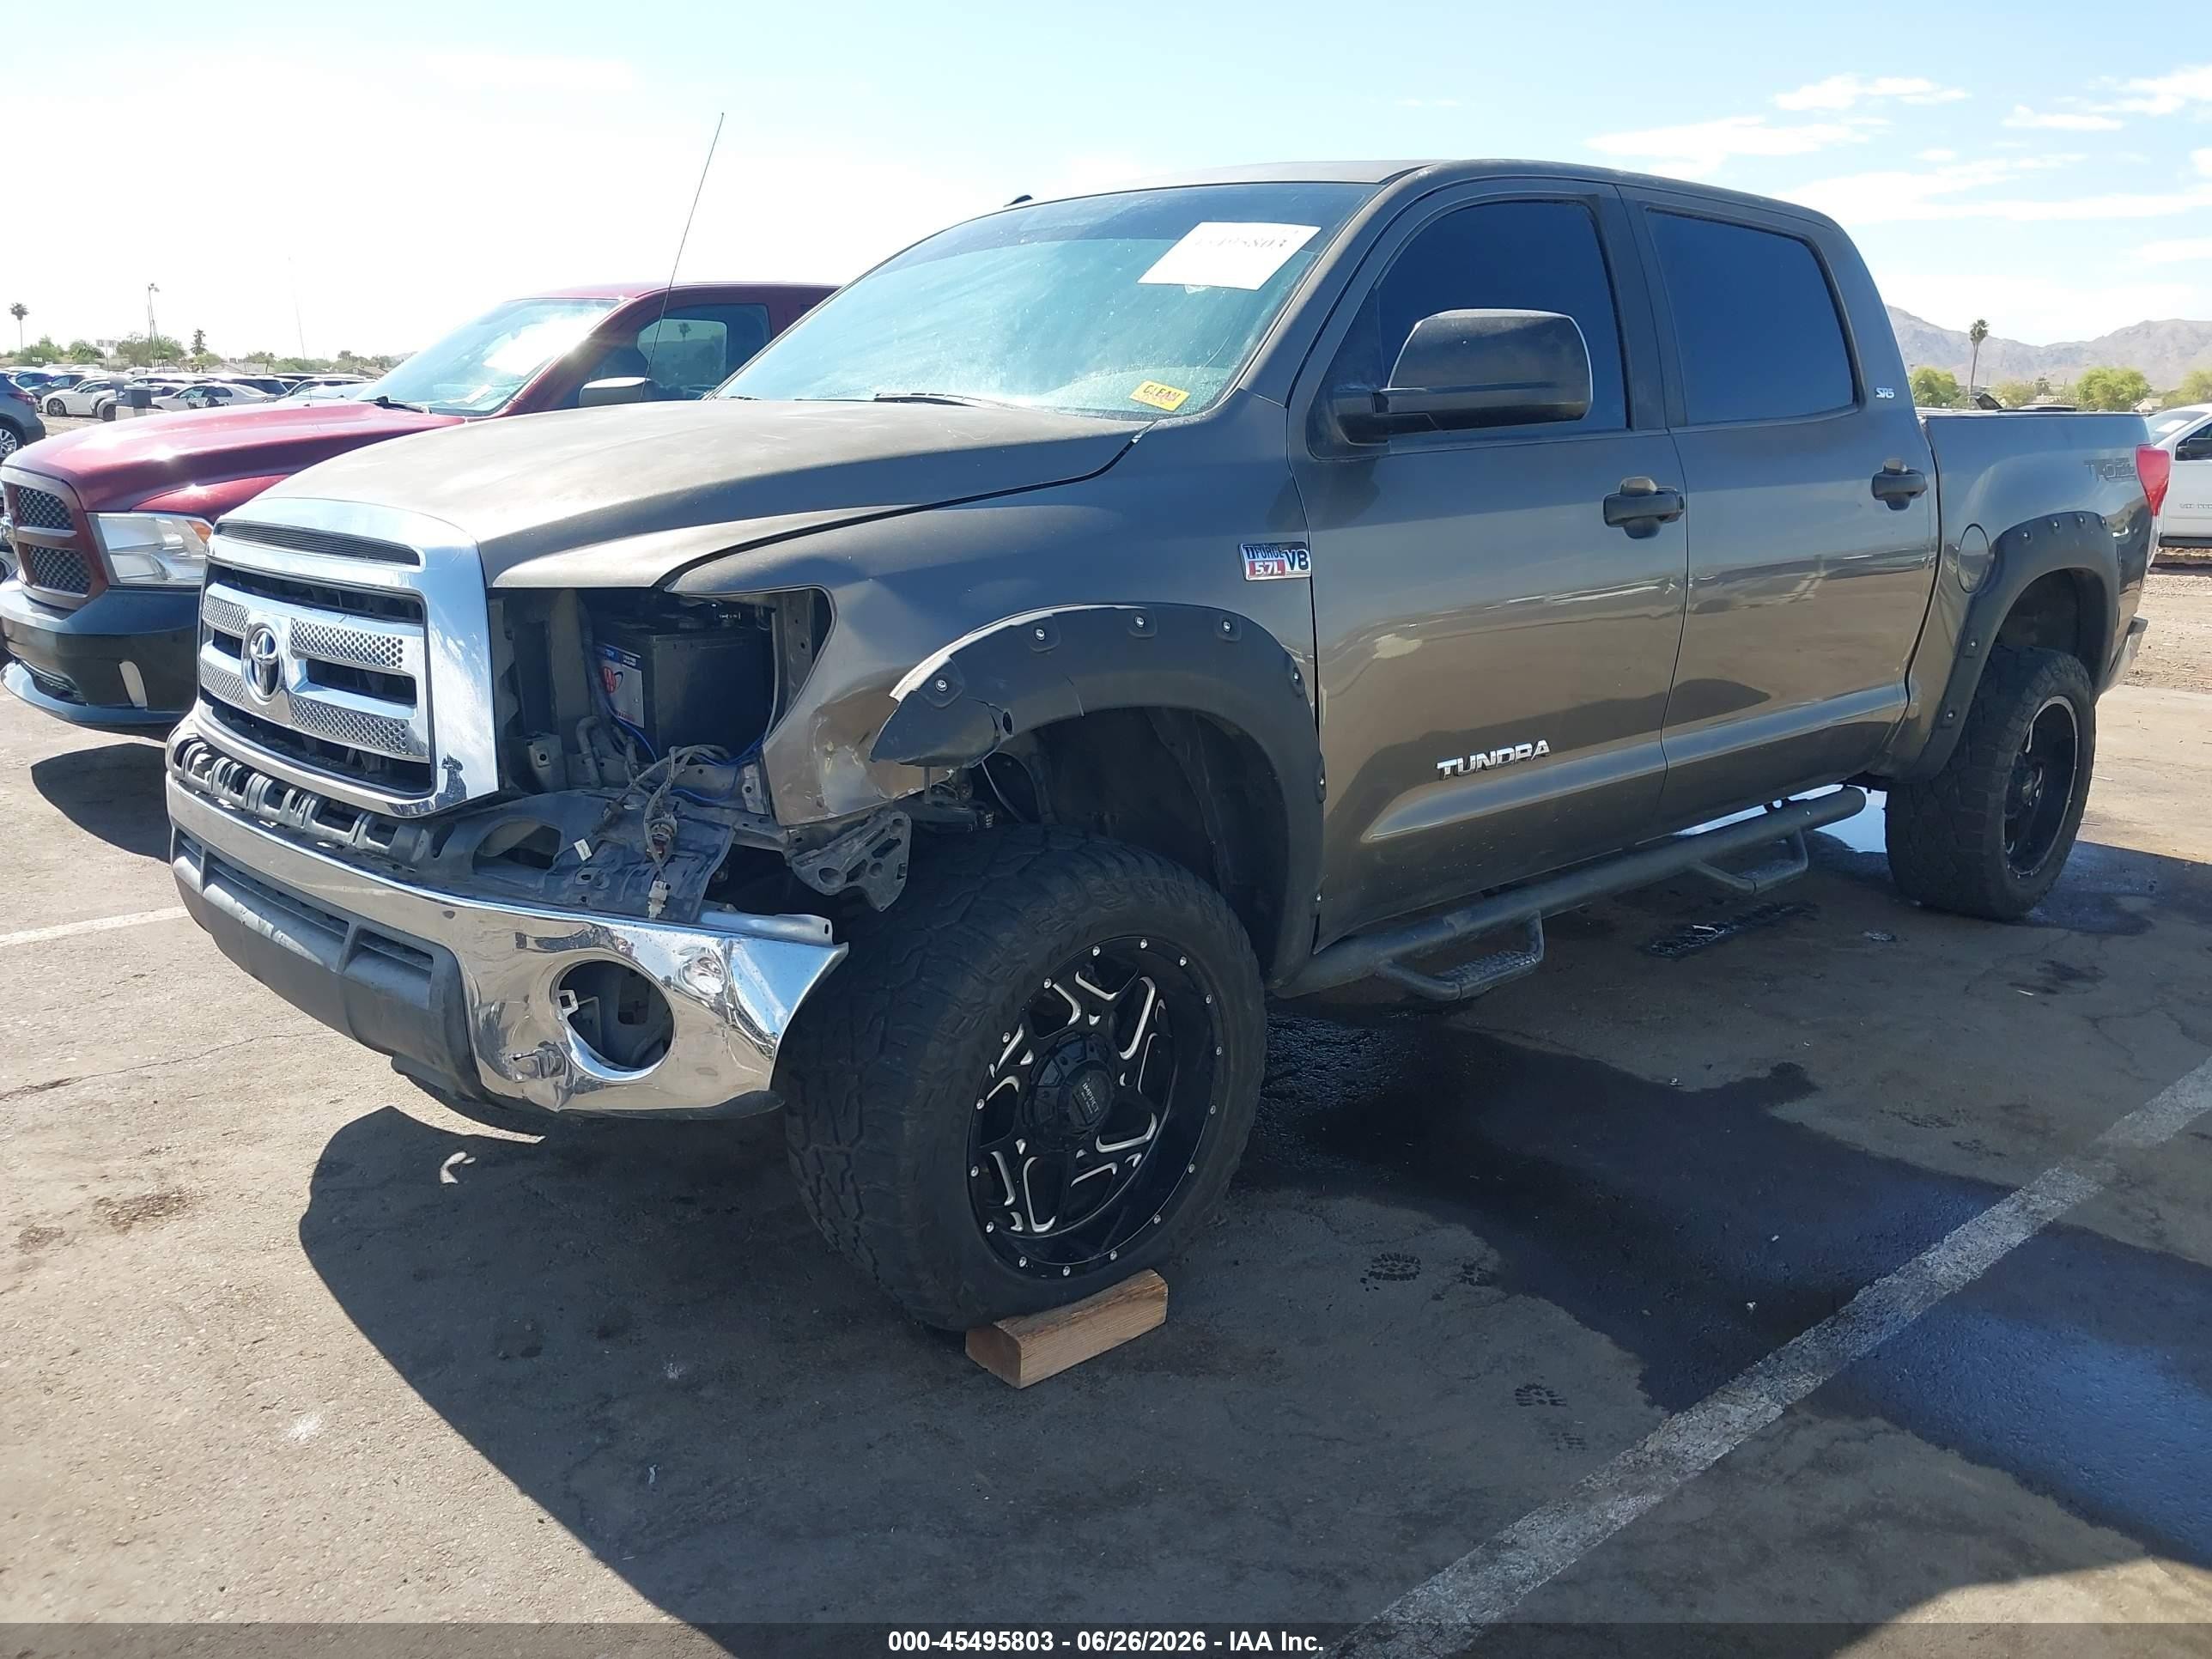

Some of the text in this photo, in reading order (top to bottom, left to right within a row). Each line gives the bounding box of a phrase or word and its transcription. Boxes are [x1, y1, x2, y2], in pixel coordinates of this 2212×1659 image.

[1875, 387, 1895, 399] SR5
[1285, 549, 1310, 571] V8
[1436, 738, 1551, 780] TUNDRA
